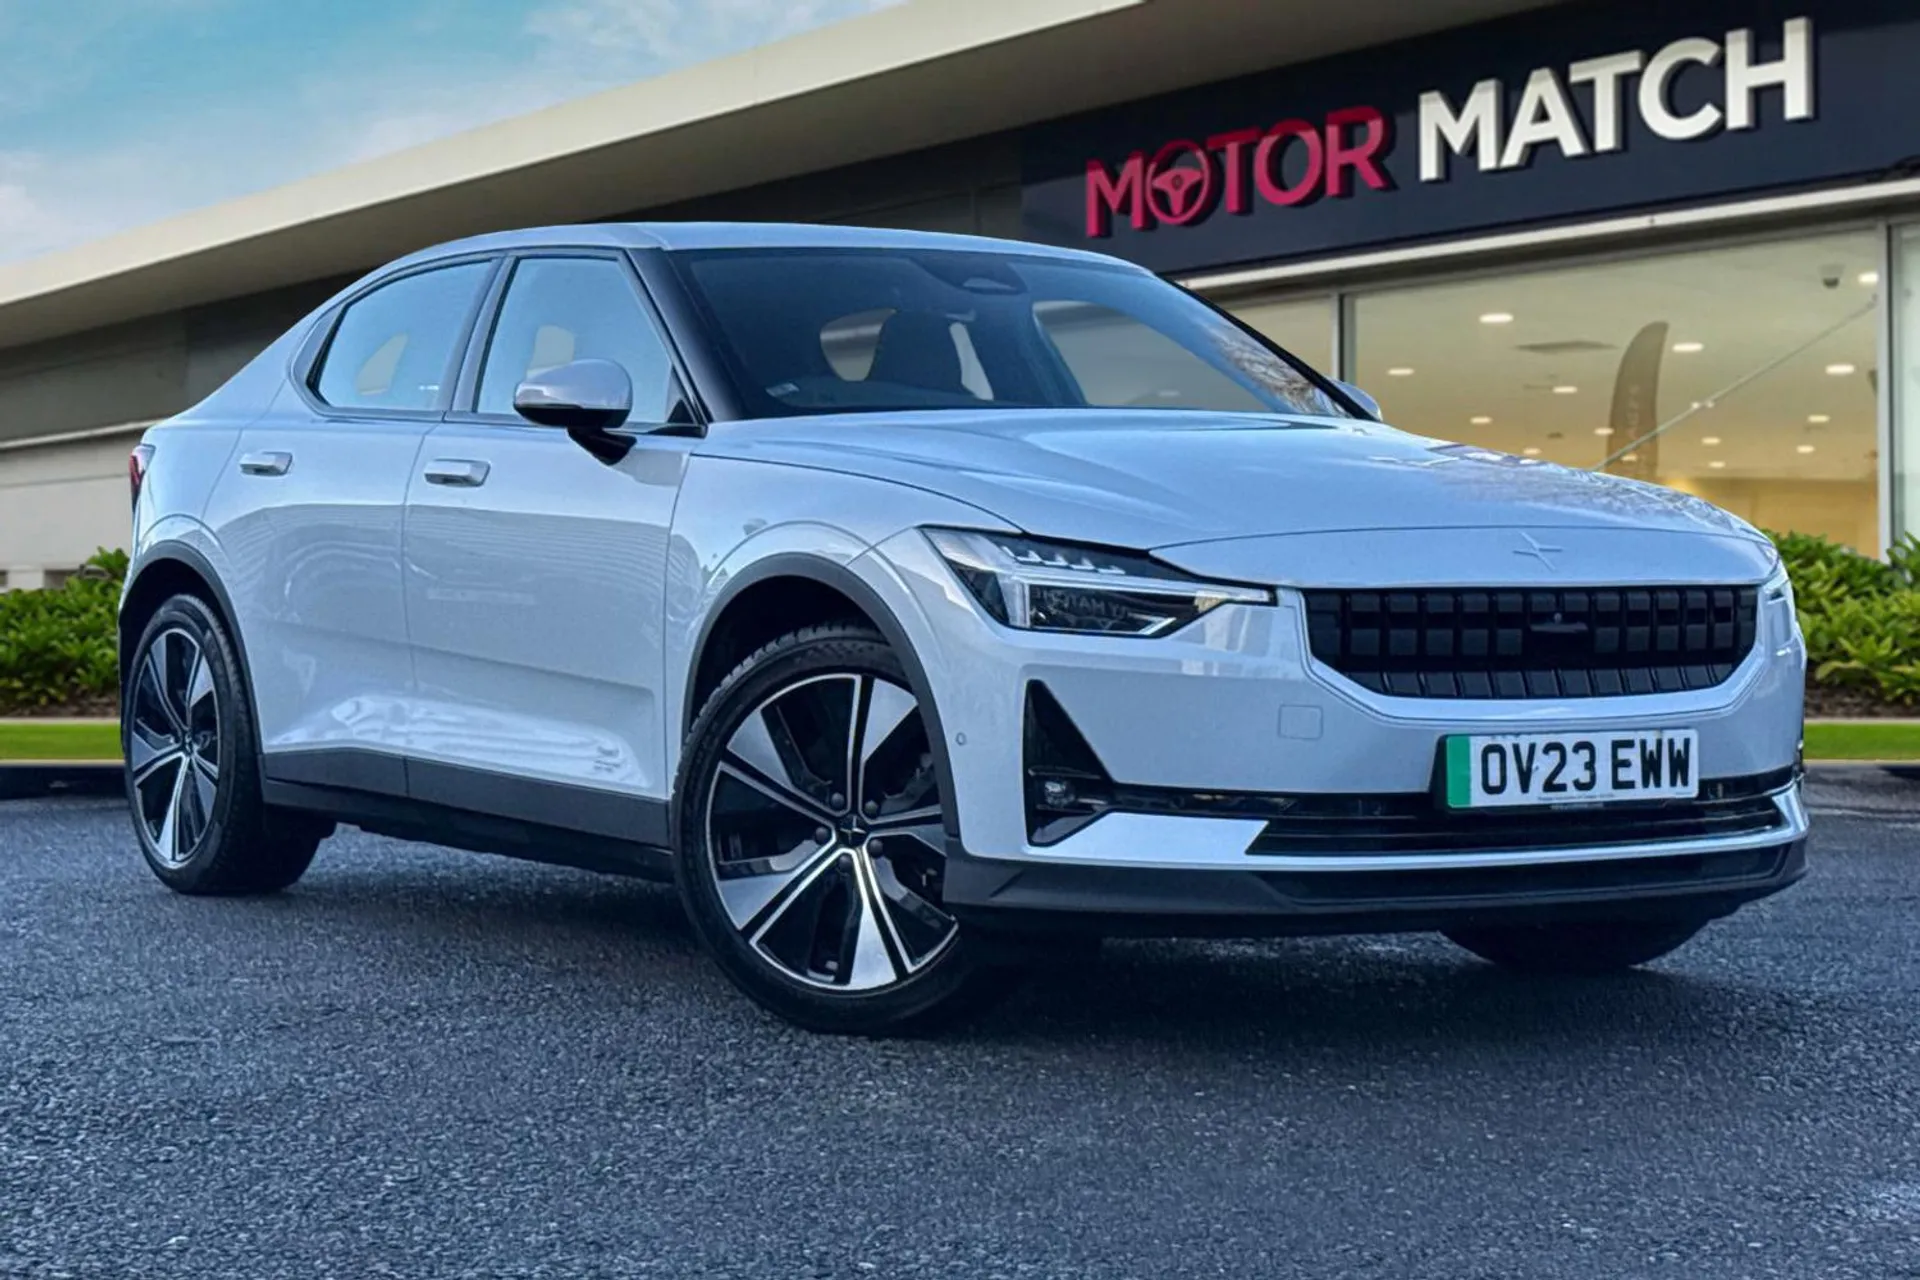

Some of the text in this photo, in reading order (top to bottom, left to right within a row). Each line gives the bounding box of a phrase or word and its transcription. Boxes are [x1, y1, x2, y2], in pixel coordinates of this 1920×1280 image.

[1086, 16, 1814, 238] MOTOR MATCH
[1480, 737, 1691, 795] OV23 EWW
